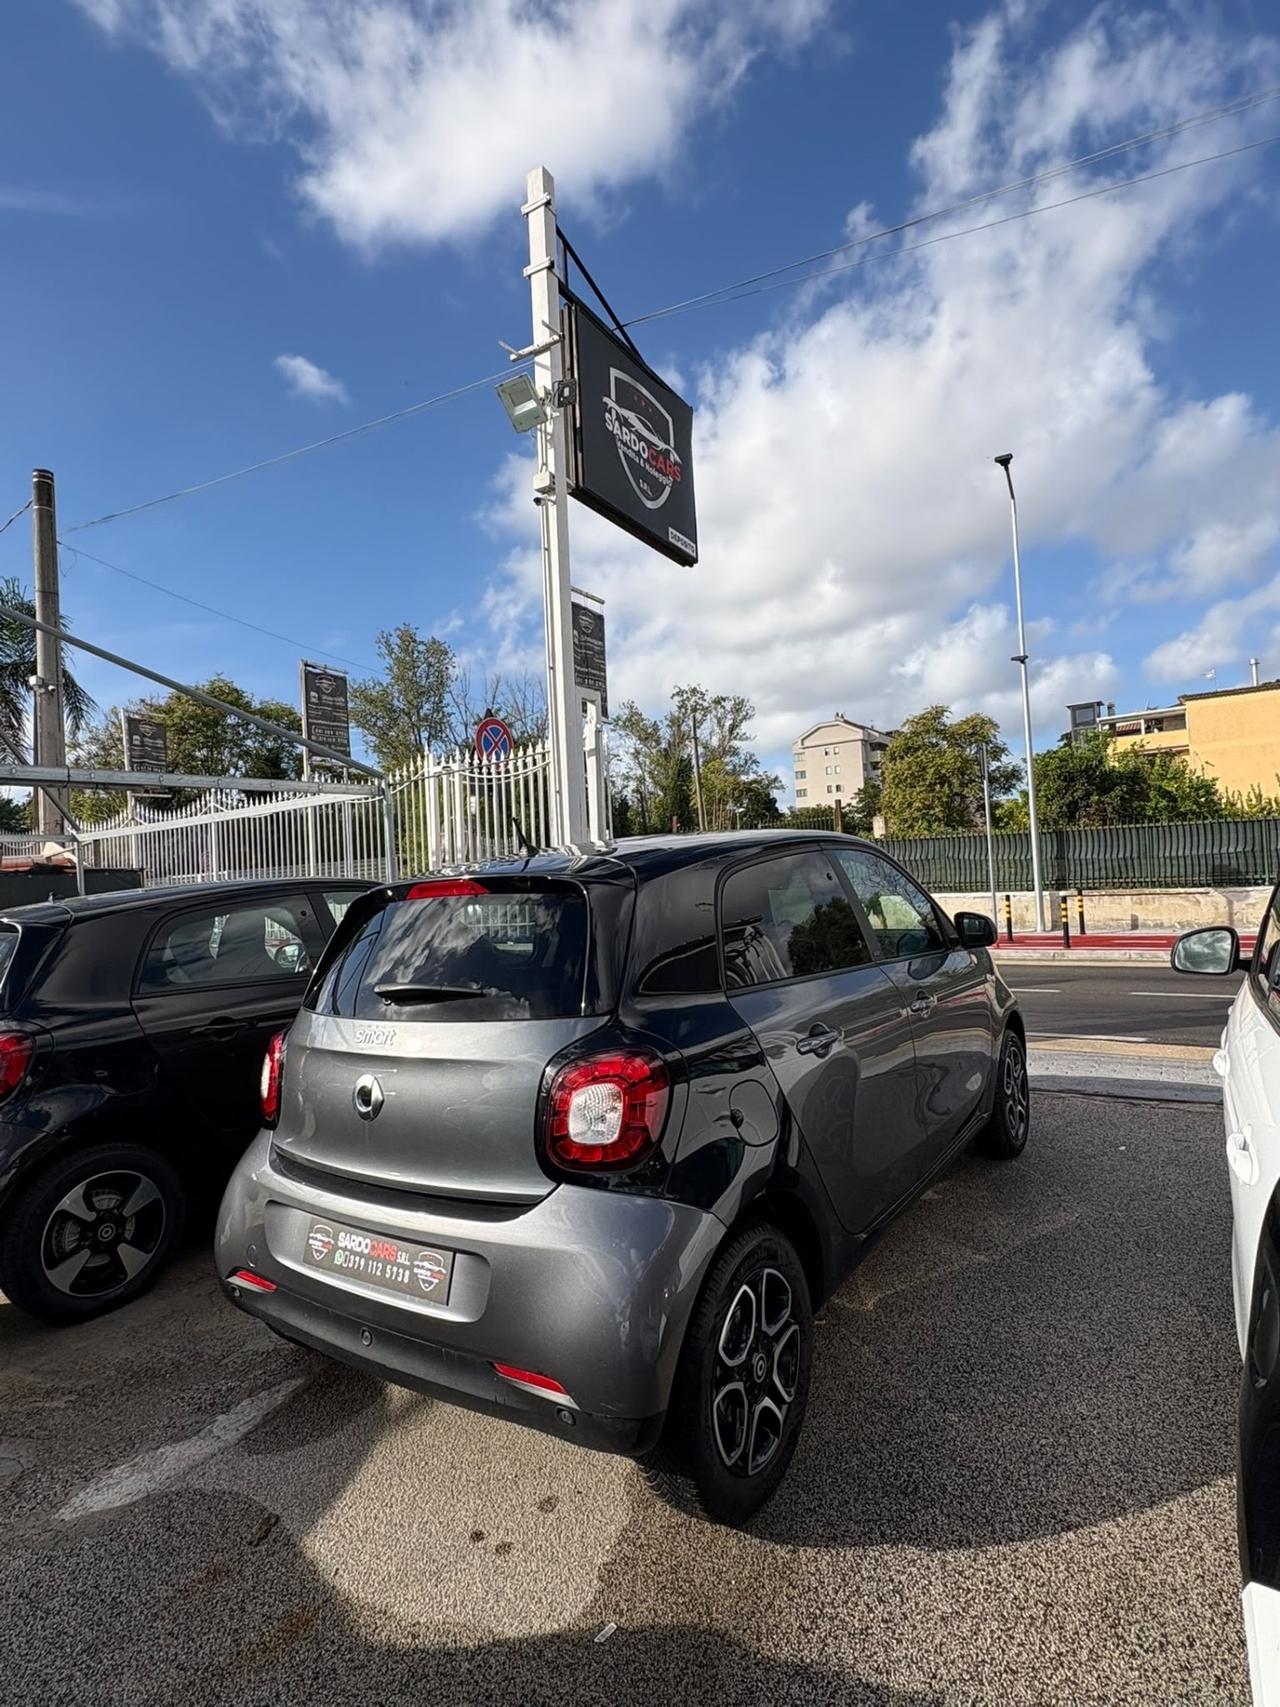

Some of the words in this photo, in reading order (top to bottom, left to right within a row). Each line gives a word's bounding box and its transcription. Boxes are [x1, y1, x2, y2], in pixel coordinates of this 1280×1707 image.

[605, 411, 681, 482] SARDOCARS
[670, 530, 695, 554] DEPOSITO
[356, 1027, 398, 1046] smart
[337, 1231, 398, 1264] SARDOCARS
[348, 1252, 365, 1271] 379
[367, 1259, 383, 1276] 112
